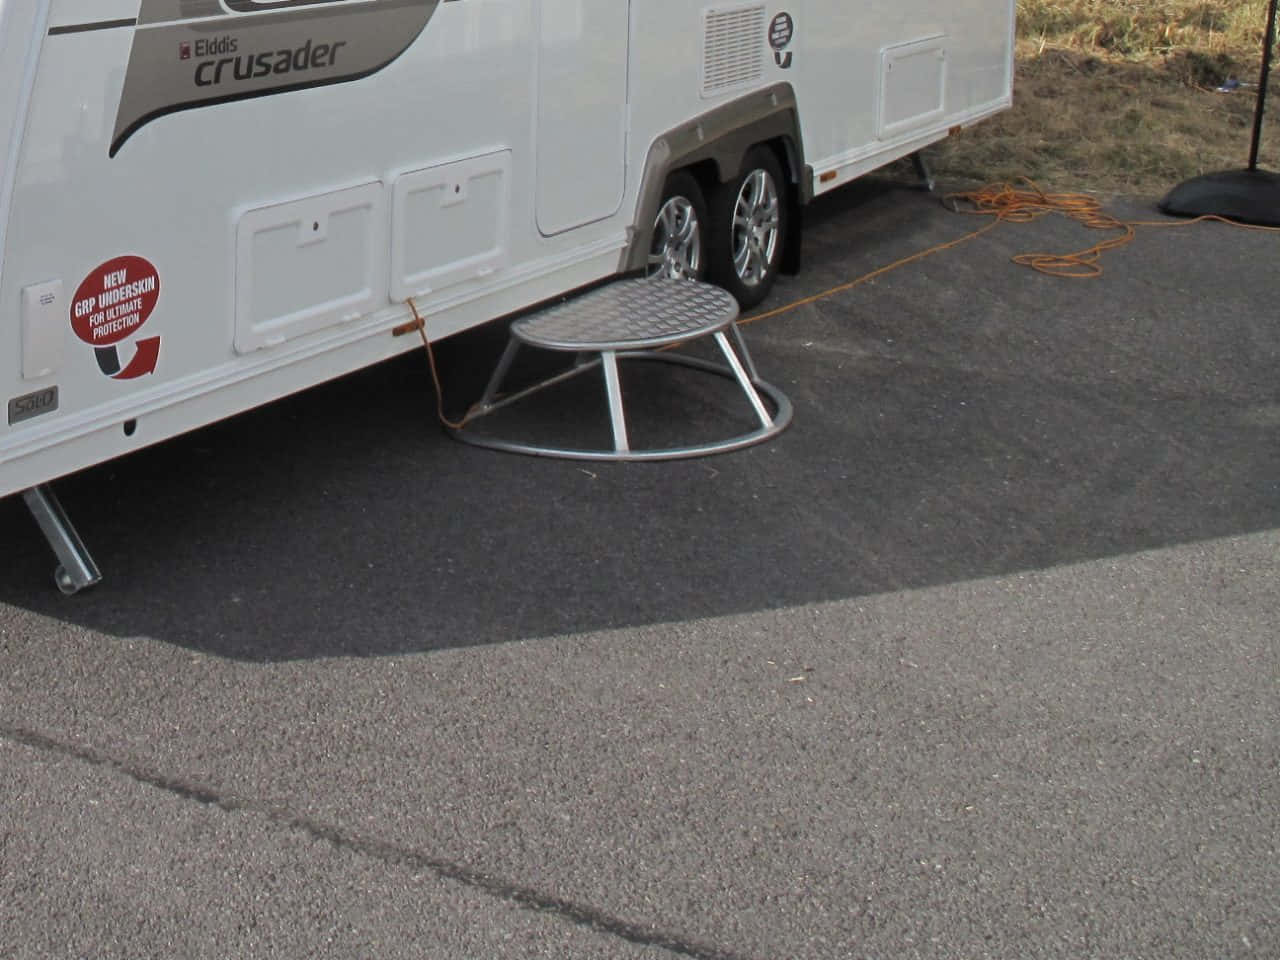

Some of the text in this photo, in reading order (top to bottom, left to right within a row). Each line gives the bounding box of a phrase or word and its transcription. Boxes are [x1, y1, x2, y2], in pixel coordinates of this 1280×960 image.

[194, 35, 239, 57] Elddis
[194, 39, 347, 87] crusader
[103, 268, 127, 290] NEW
[75, 297, 96, 318] GRP
[98, 275, 155, 308] UNDERSKIN
[89, 298, 143, 328] FOR ULTIMATE
[93, 312, 140, 340] PROTECTION
